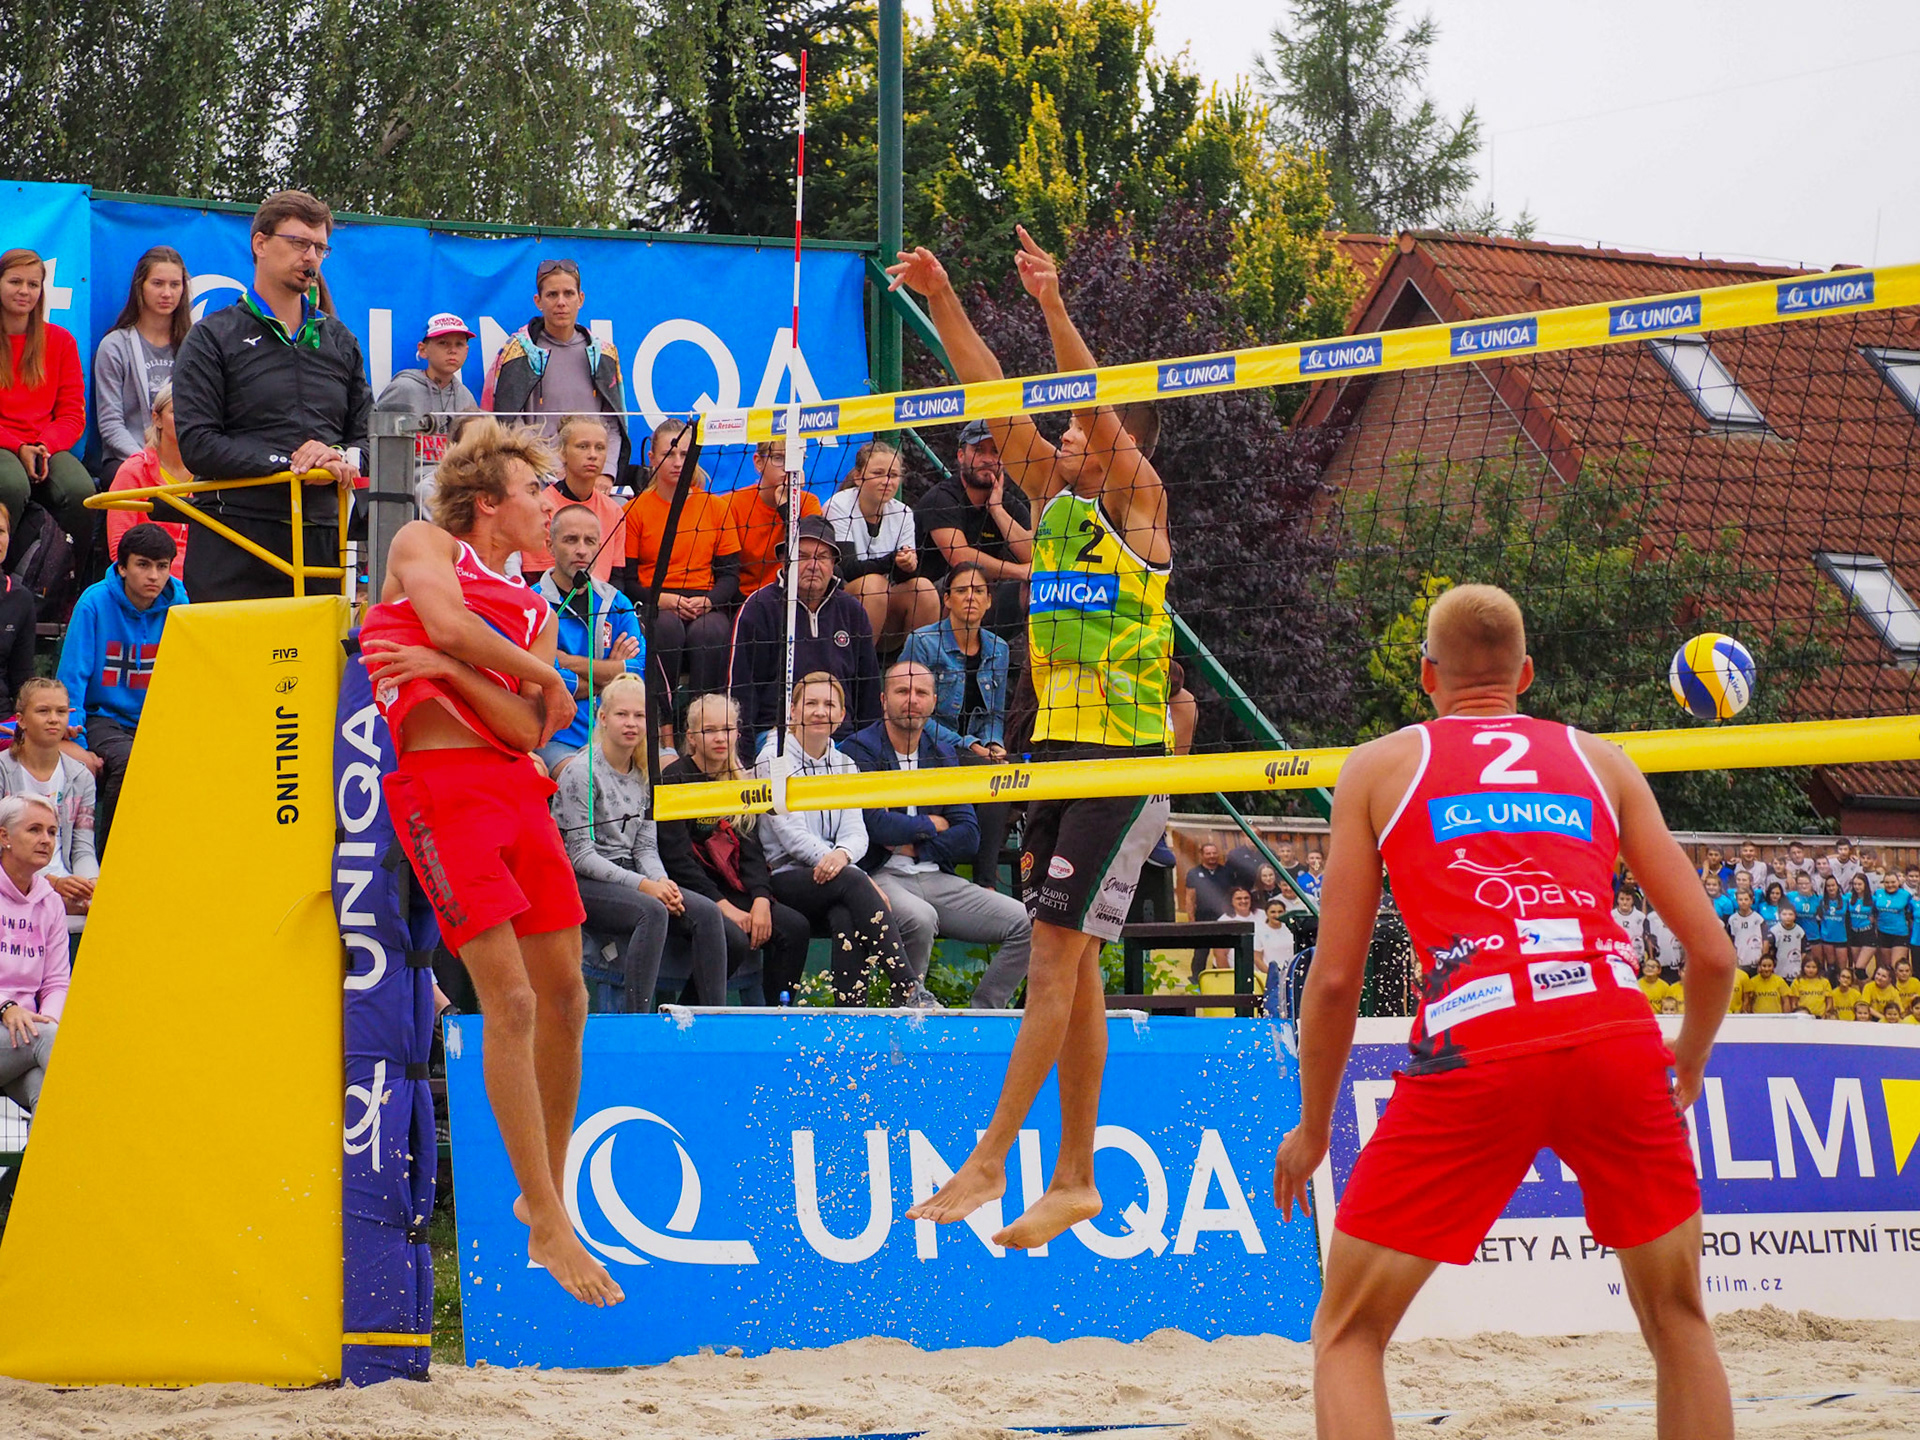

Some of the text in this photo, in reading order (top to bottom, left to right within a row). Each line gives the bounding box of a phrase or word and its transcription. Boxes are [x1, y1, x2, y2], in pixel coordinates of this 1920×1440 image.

[1810, 281, 1866, 305] UNIQA
[1641, 304, 1694, 328] UNIQA
[1481, 326, 1531, 348] UNIQA
[145, 358, 175, 370] OLLIST
[1328, 346, 1376, 366] UNIQA
[1184, 363, 1229, 385] UNIQA
[1048, 380, 1091, 402] UNIQA
[918, 397, 959, 416] UNIQA
[1075, 519, 1106, 564] 2
[1039, 583, 1109, 604] UNIQA
[275, 705, 299, 825] JINLING
[1264, 755, 1310, 785] gala
[1472, 731, 1539, 784] 2
[989, 769, 1032, 798] gala
[1487, 803, 1585, 831] UNIQA
[338, 702, 388, 990] UNIQA
[0, 943, 45, 958] RMUR
[1430, 985, 1503, 1019] WITZENMANN
[791, 1125, 1268, 1263] UNIQA
[1474, 1236, 1539, 1264] ETY
[1549, 1235, 1571, 1260] A
[1701, 1231, 1740, 1256] RO
[1750, 1223, 1878, 1256] KVALITNÍ
